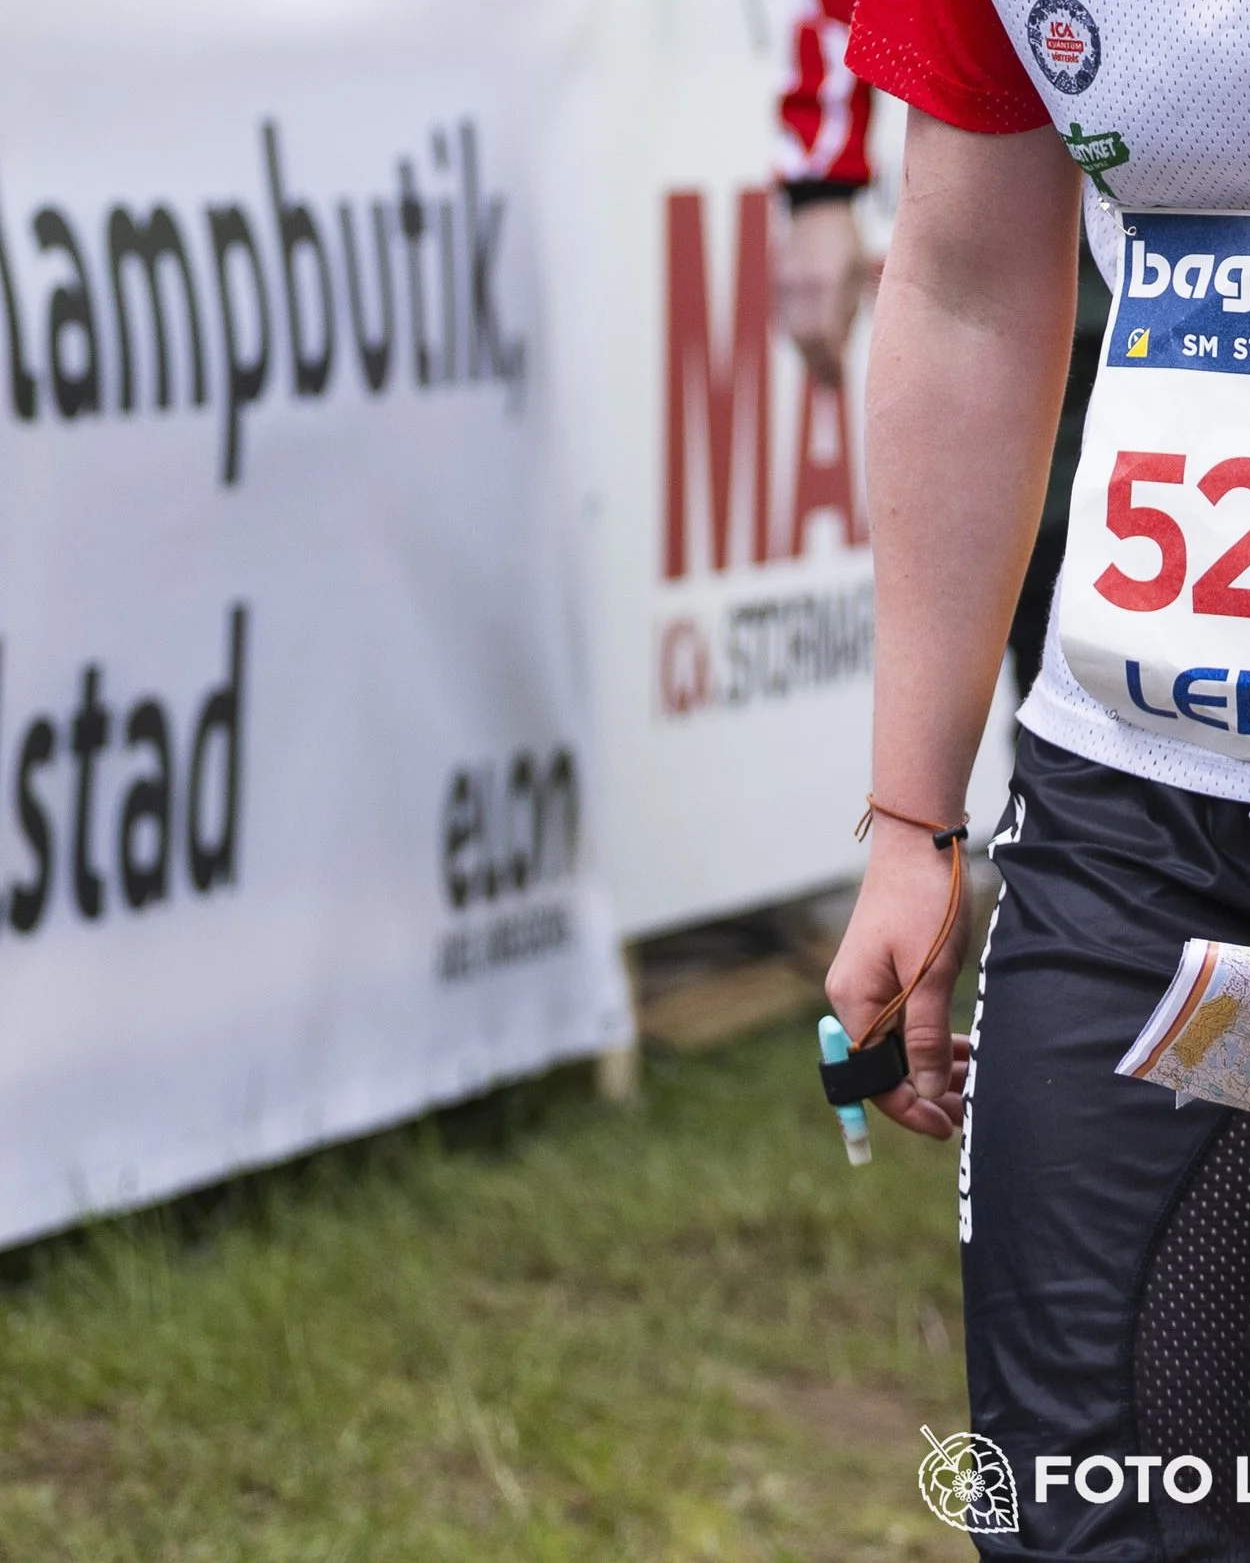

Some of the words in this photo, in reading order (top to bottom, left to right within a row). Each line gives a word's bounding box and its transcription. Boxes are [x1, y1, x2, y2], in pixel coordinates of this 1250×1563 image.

[1049, 21, 1075, 39] ICA
[663, 188, 874, 583] MA
[1181, 333, 1219, 358] SM
[0, 598, 250, 935] stad
